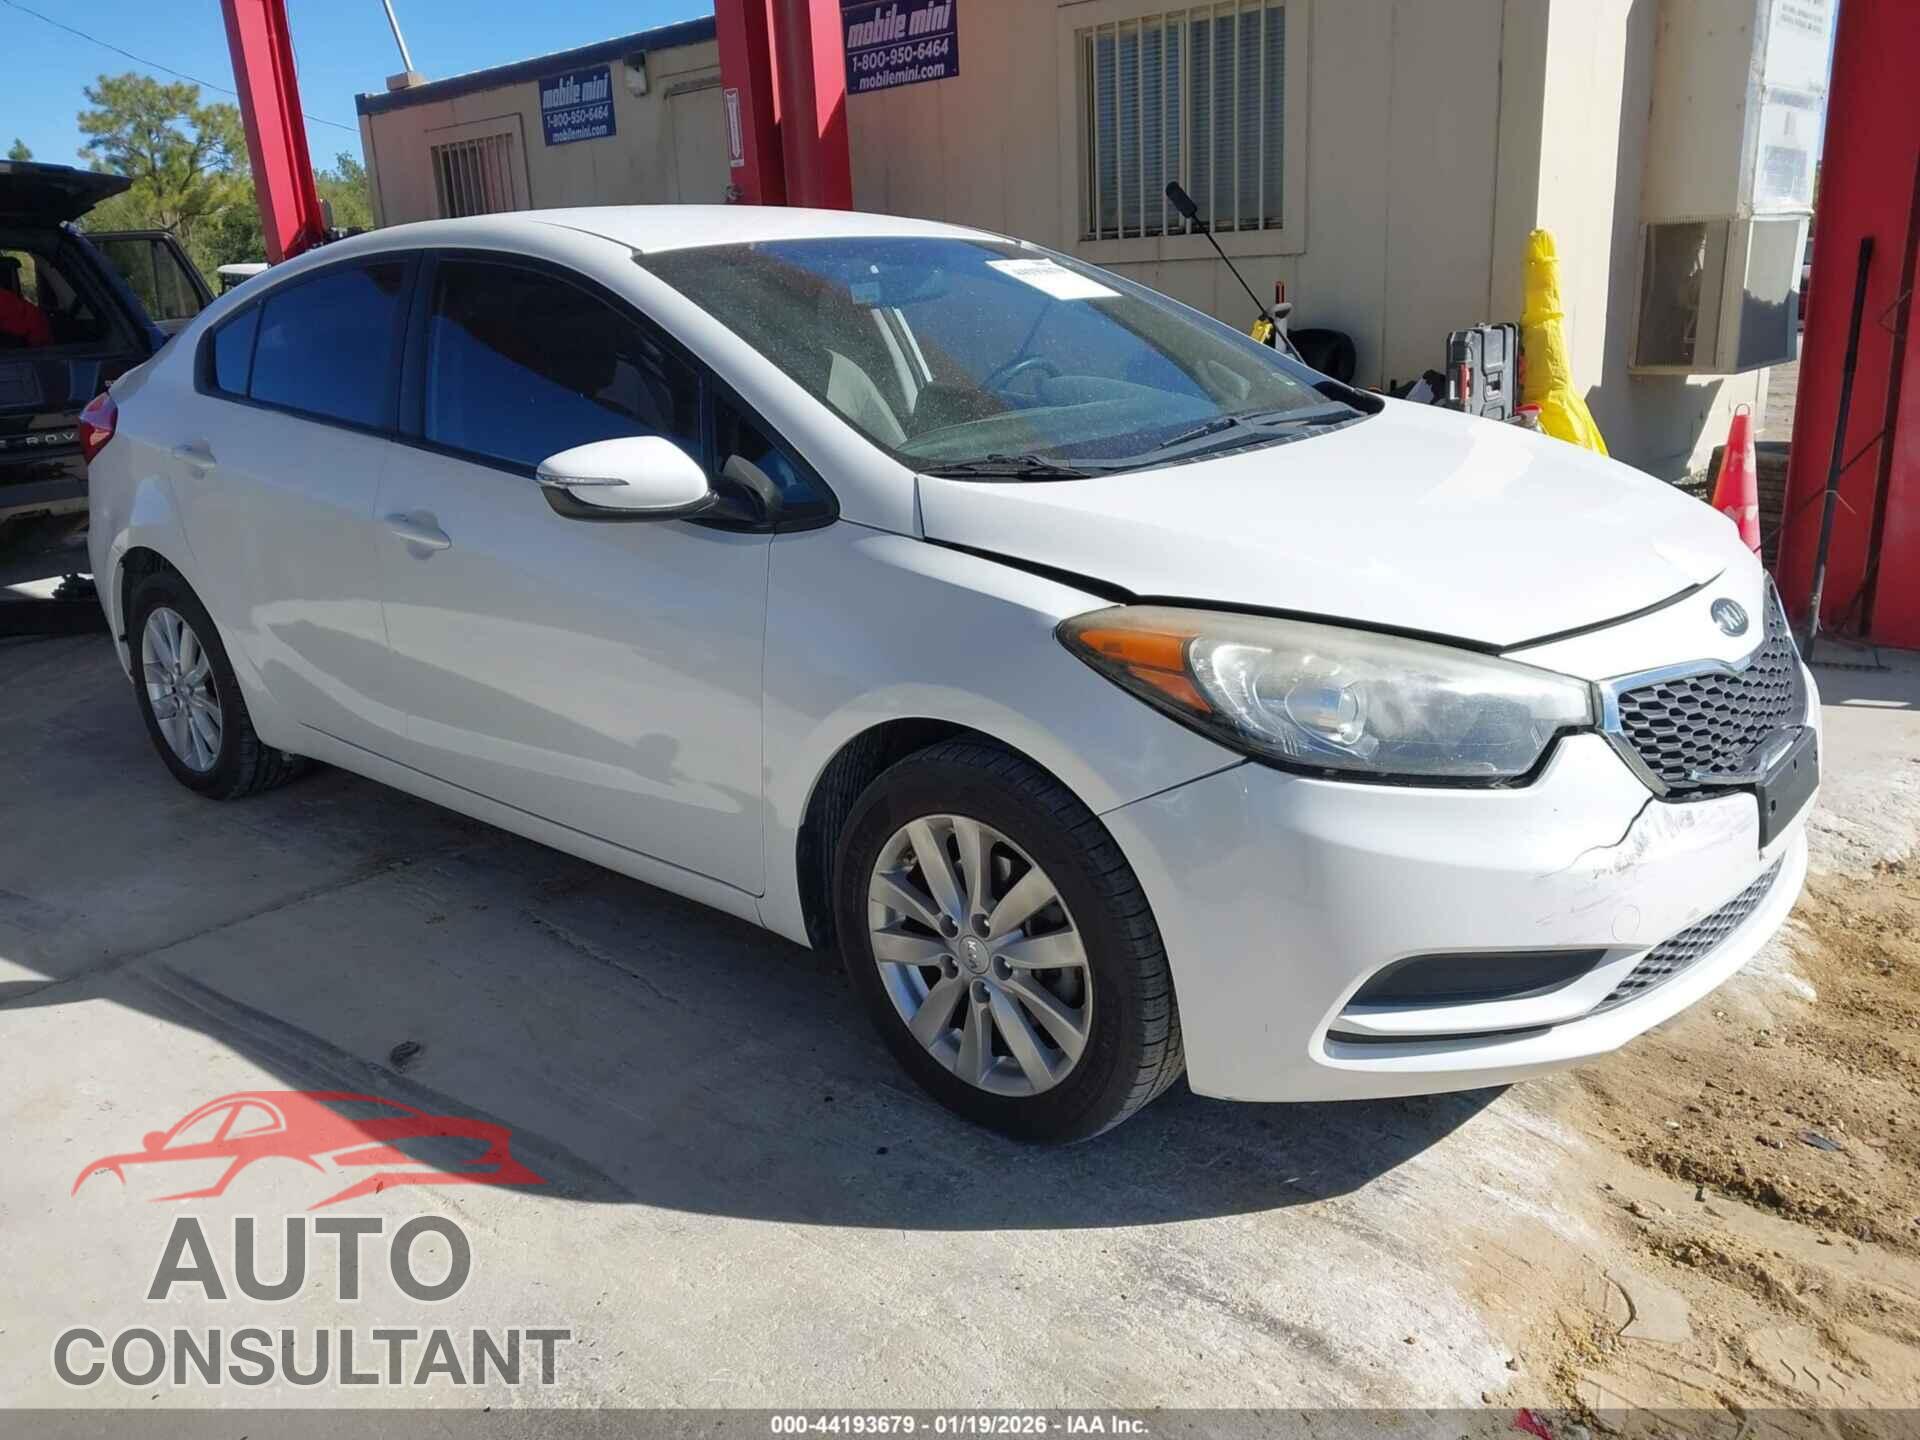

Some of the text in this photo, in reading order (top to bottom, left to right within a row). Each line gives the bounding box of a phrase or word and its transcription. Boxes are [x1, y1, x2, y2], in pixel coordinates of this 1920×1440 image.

[847, 0, 952, 48] mobile mini
[852, 38, 949, 72] 1-800-950-6464
[543, 72, 608, 109] mobile mini
[859, 63, 945, 89] mobilemini.com
[547, 105, 609, 128] 1-800-950-6464
[552, 125, 608, 142] mobilemini.com
